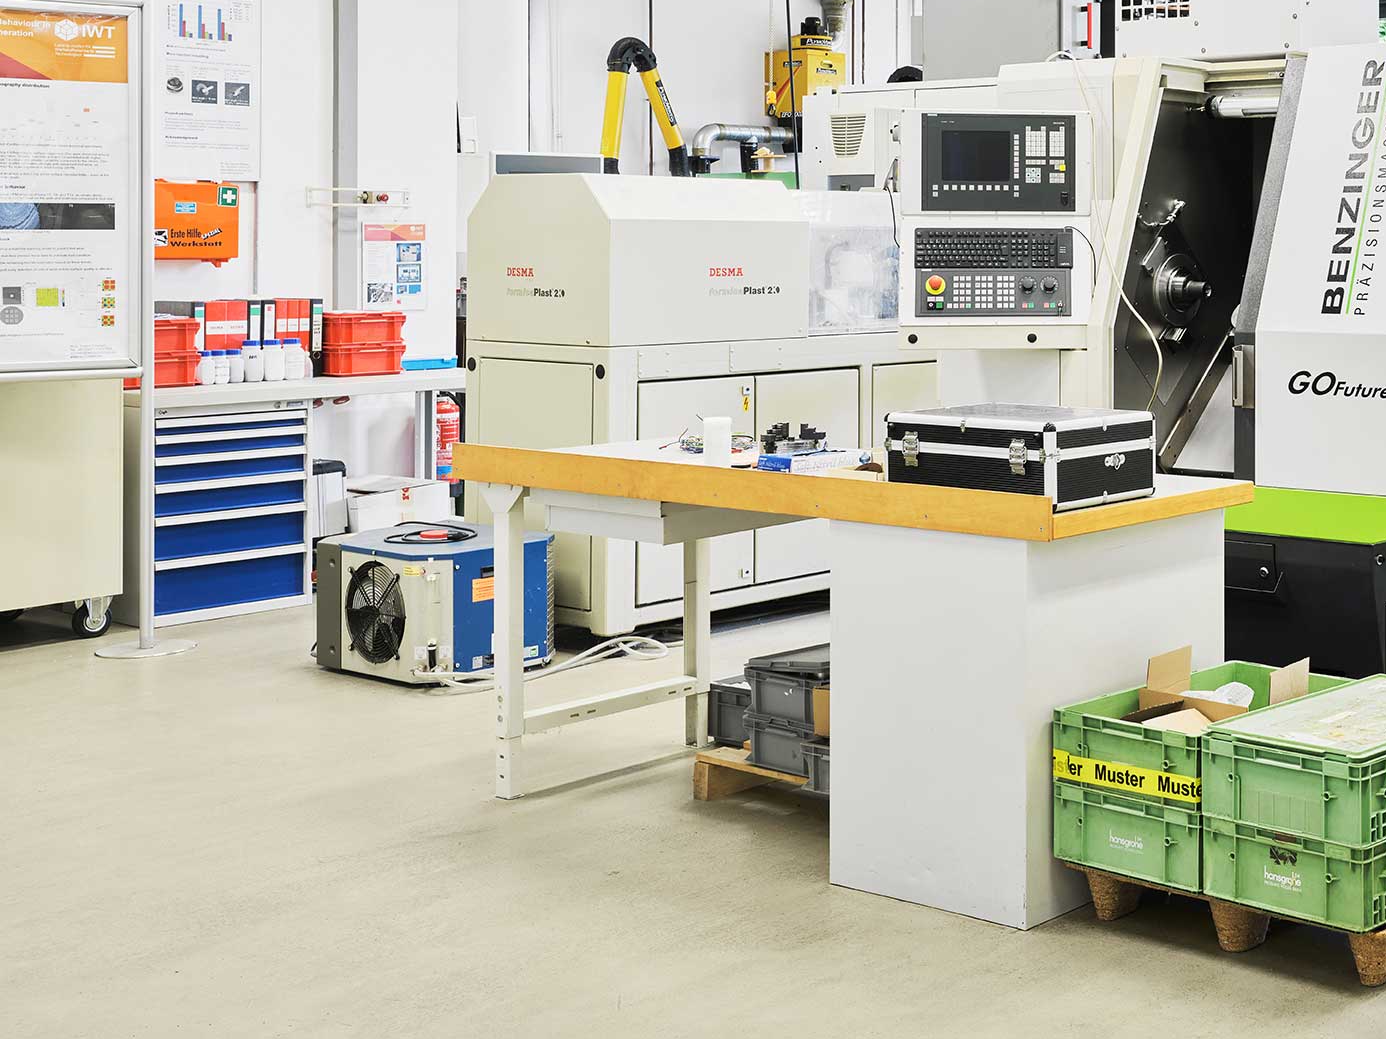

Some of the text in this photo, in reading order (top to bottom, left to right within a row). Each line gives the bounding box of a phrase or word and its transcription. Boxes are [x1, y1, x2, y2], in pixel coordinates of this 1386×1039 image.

[81, 24, 116, 39] IWT
[1321, 59, 1386, 315] BENZINGER
[170, 228, 186, 239] Erste
[186, 228, 202, 239] Hilfe
[506, 266, 535, 278] DESMA
[708, 267, 744, 277] DESMA
[1094, 763, 1146, 789] Muster
